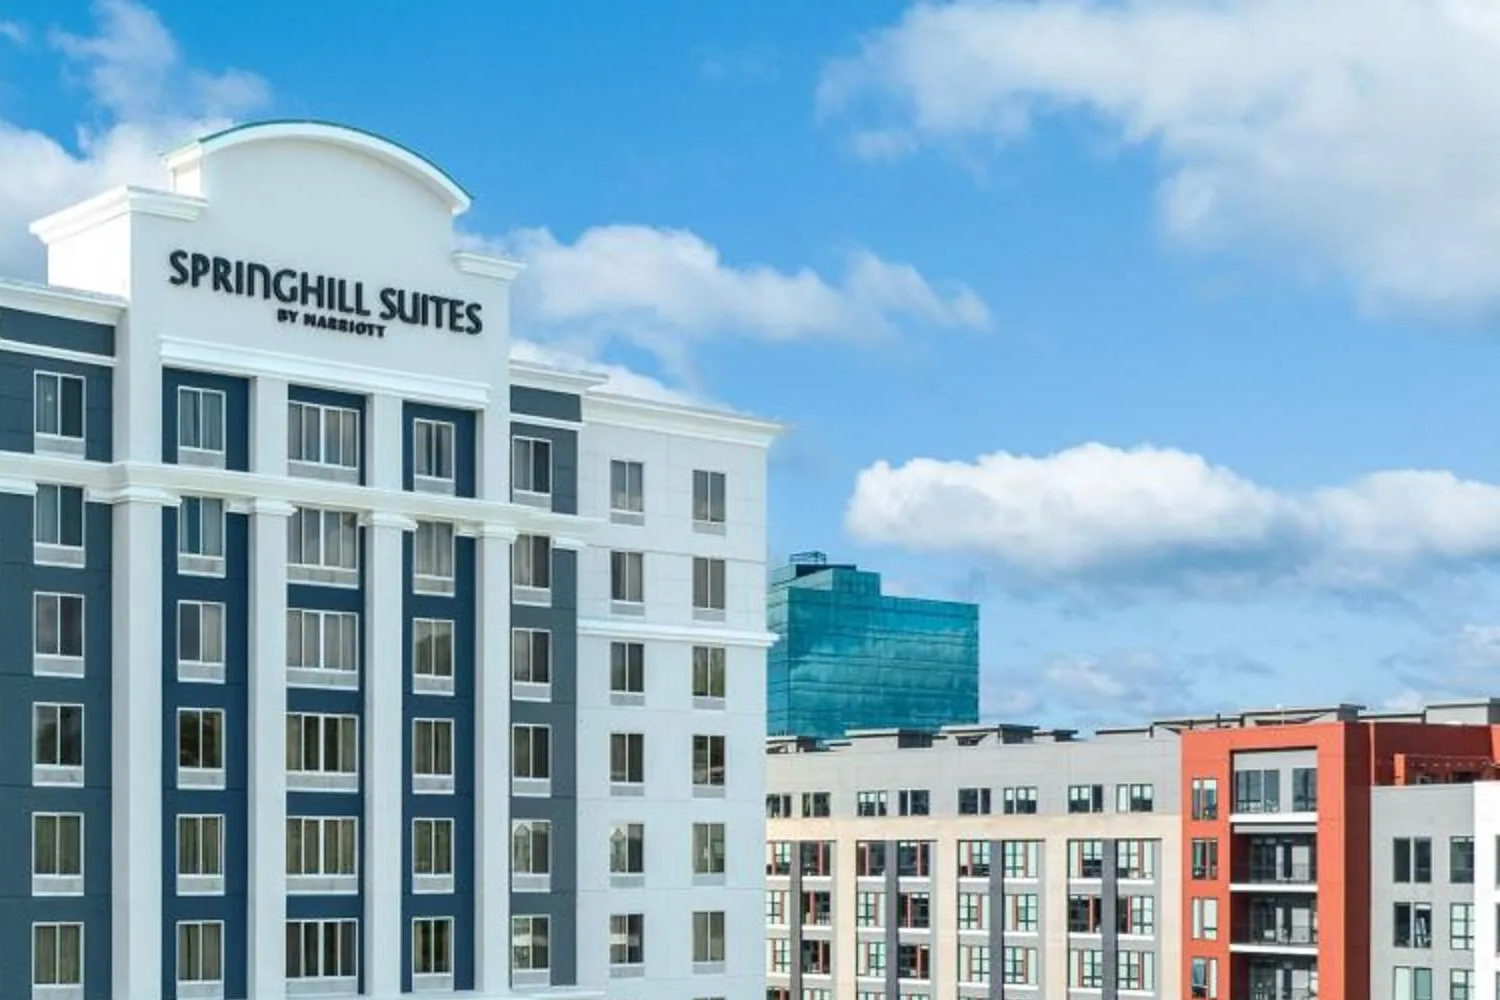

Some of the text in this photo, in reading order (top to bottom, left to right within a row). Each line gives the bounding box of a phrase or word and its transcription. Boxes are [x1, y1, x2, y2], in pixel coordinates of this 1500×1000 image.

[169, 250, 483, 335] SPRINGHILL SUITES
[277, 308, 387, 338] BY MARRIOTT
